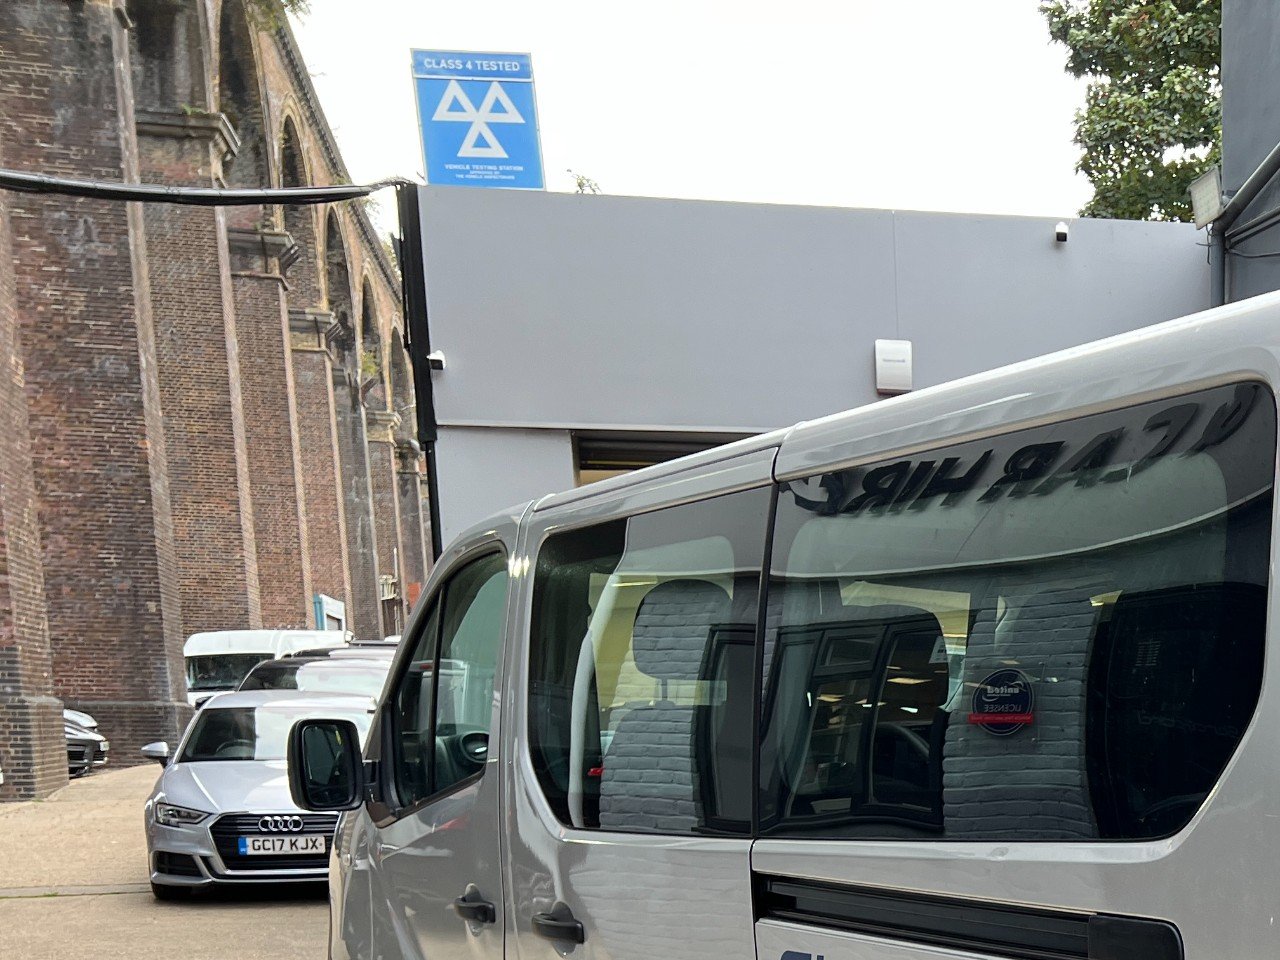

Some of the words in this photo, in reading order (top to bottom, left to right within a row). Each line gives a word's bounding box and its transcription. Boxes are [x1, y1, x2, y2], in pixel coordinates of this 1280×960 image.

[424, 58, 462, 70] CLASS
[465, 60, 472, 70] 4
[475, 60, 520, 71] TESTED
[252, 838, 285, 852] GC17
[290, 838, 318, 851] KJX
